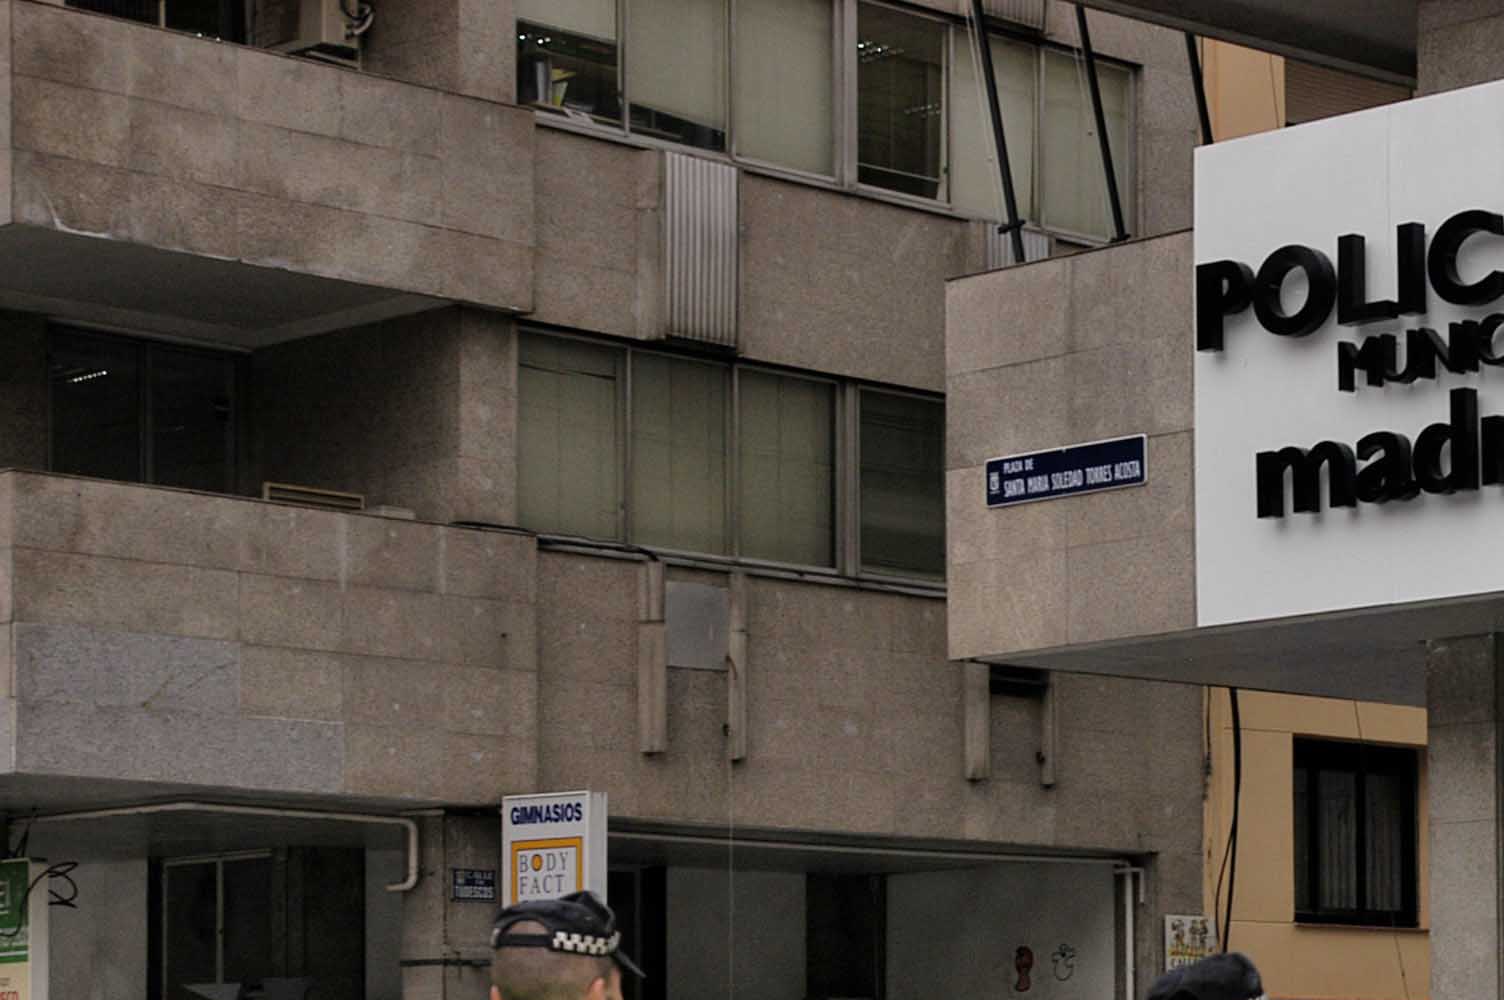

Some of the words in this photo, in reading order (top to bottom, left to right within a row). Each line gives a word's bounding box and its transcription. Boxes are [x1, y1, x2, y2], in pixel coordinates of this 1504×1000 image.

[1002, 459, 1023, 475] PLAZA
[1025, 457, 1035, 471] DE
[1004, 478, 1026, 498] SANTA
[1051, 469, 1083, 491] SOLEDAD
[1085, 464, 1113, 486] TORRES
[1114, 459, 1141, 481] ACOSTA
[511, 802, 583, 825] GIMNASIOS
[519, 851, 569, 873] BODY
[519, 874, 566, 895] FACT
